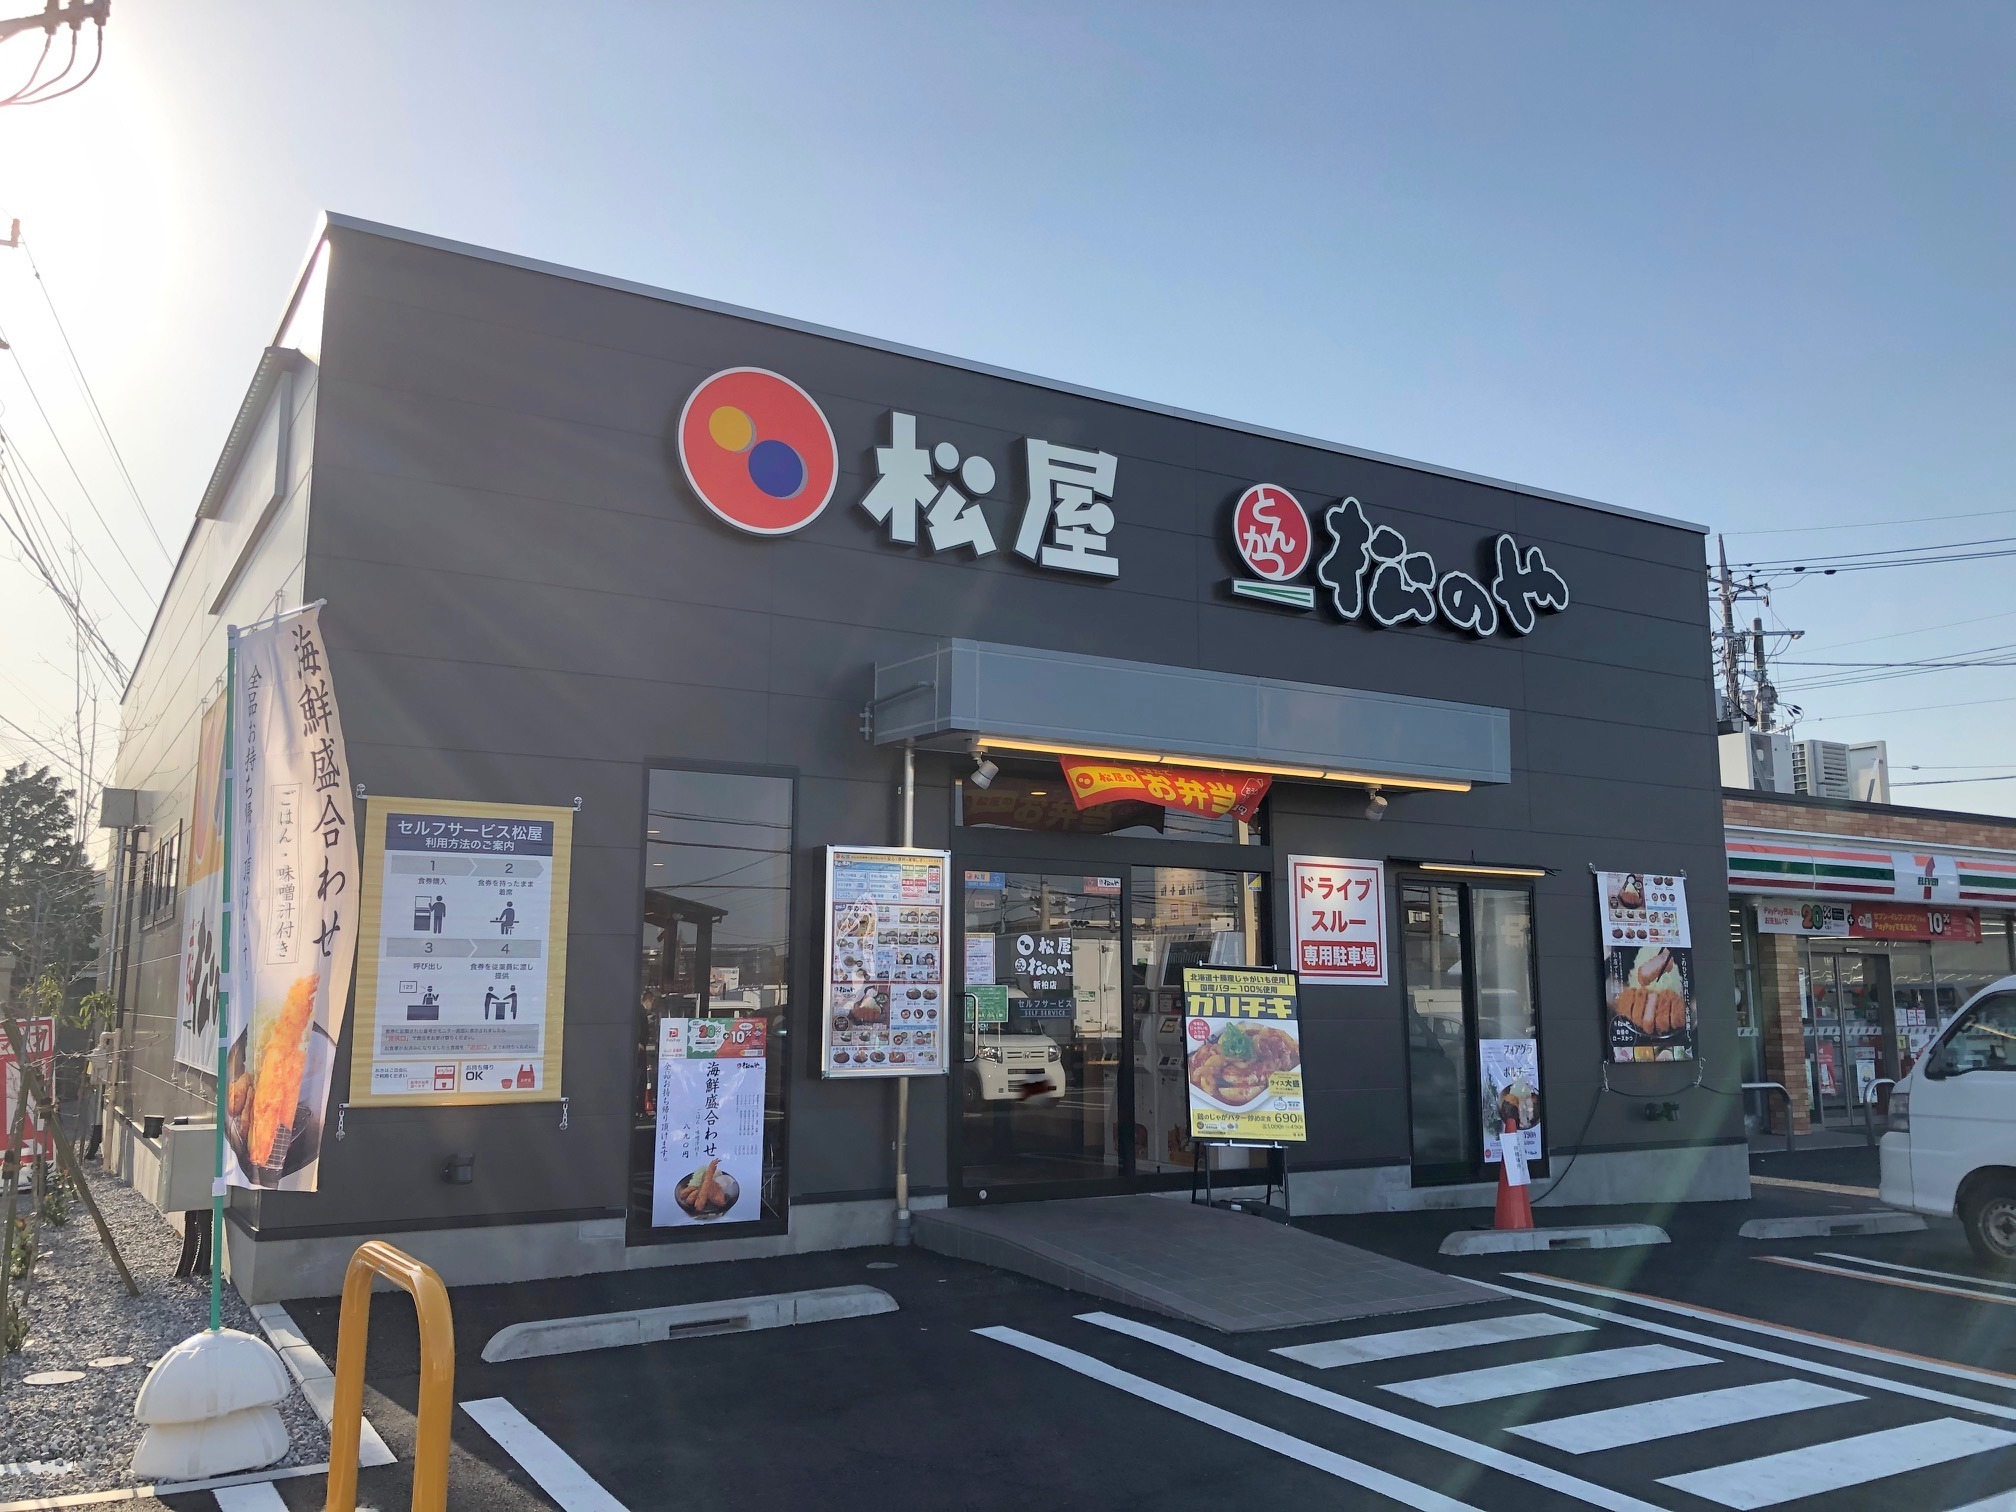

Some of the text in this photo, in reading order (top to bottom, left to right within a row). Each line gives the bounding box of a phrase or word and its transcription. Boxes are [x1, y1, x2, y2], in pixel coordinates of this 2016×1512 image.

[861, 411, 1119, 577] 松屋
[1242, 488, 1296, 577] とんかつ
[1317, 496, 1570, 636] 松のや
[291, 624, 346, 957] 海鮮盛合わせ
[1099, 772, 1137, 783] 松屋の
[1140, 773, 1237, 813] お弁当
[397, 820, 543, 841] セルフサービス松屋
[425, 837, 515, 851] 利用方法のご案内
[430, 860, 435, 871] 1
[505, 863, 513, 874] 2
[275, 789, 297, 958] ごはん・味噌汁付き
[418, 877, 448, 886] 食券購入
[477, 879, 534, 888] 食券を持ったまま
[1300, 875, 1373, 901] ドライブ
[499, 888, 513, 896] 着席
[1311, 910, 1366, 933] スルー
[424, 942, 433, 953] 3
[501, 943, 510, 954] 4
[1038, 936, 1072, 955] 松屋
[1303, 944, 1376, 967] 専用駐車場
[413, 962, 443, 971] 呼び出し
[470, 963, 534, 971] 食券を従業員に渡し
[1027, 957, 1072, 976] 松のや
[494, 972, 509, 980] 提供
[1033, 980, 1057, 990] 新柏店
[1200, 983, 1278, 994] 国産バター 100%使用
[1017, 1000, 1072, 1008] セルフサービス
[1187, 993, 1292, 1019] ガリチキ
[1503, 1044, 1533, 1056] フォアグラ
[465, 1071, 484, 1081] OK
[703, 1061, 720, 1158] 海鮮盛合わせ
